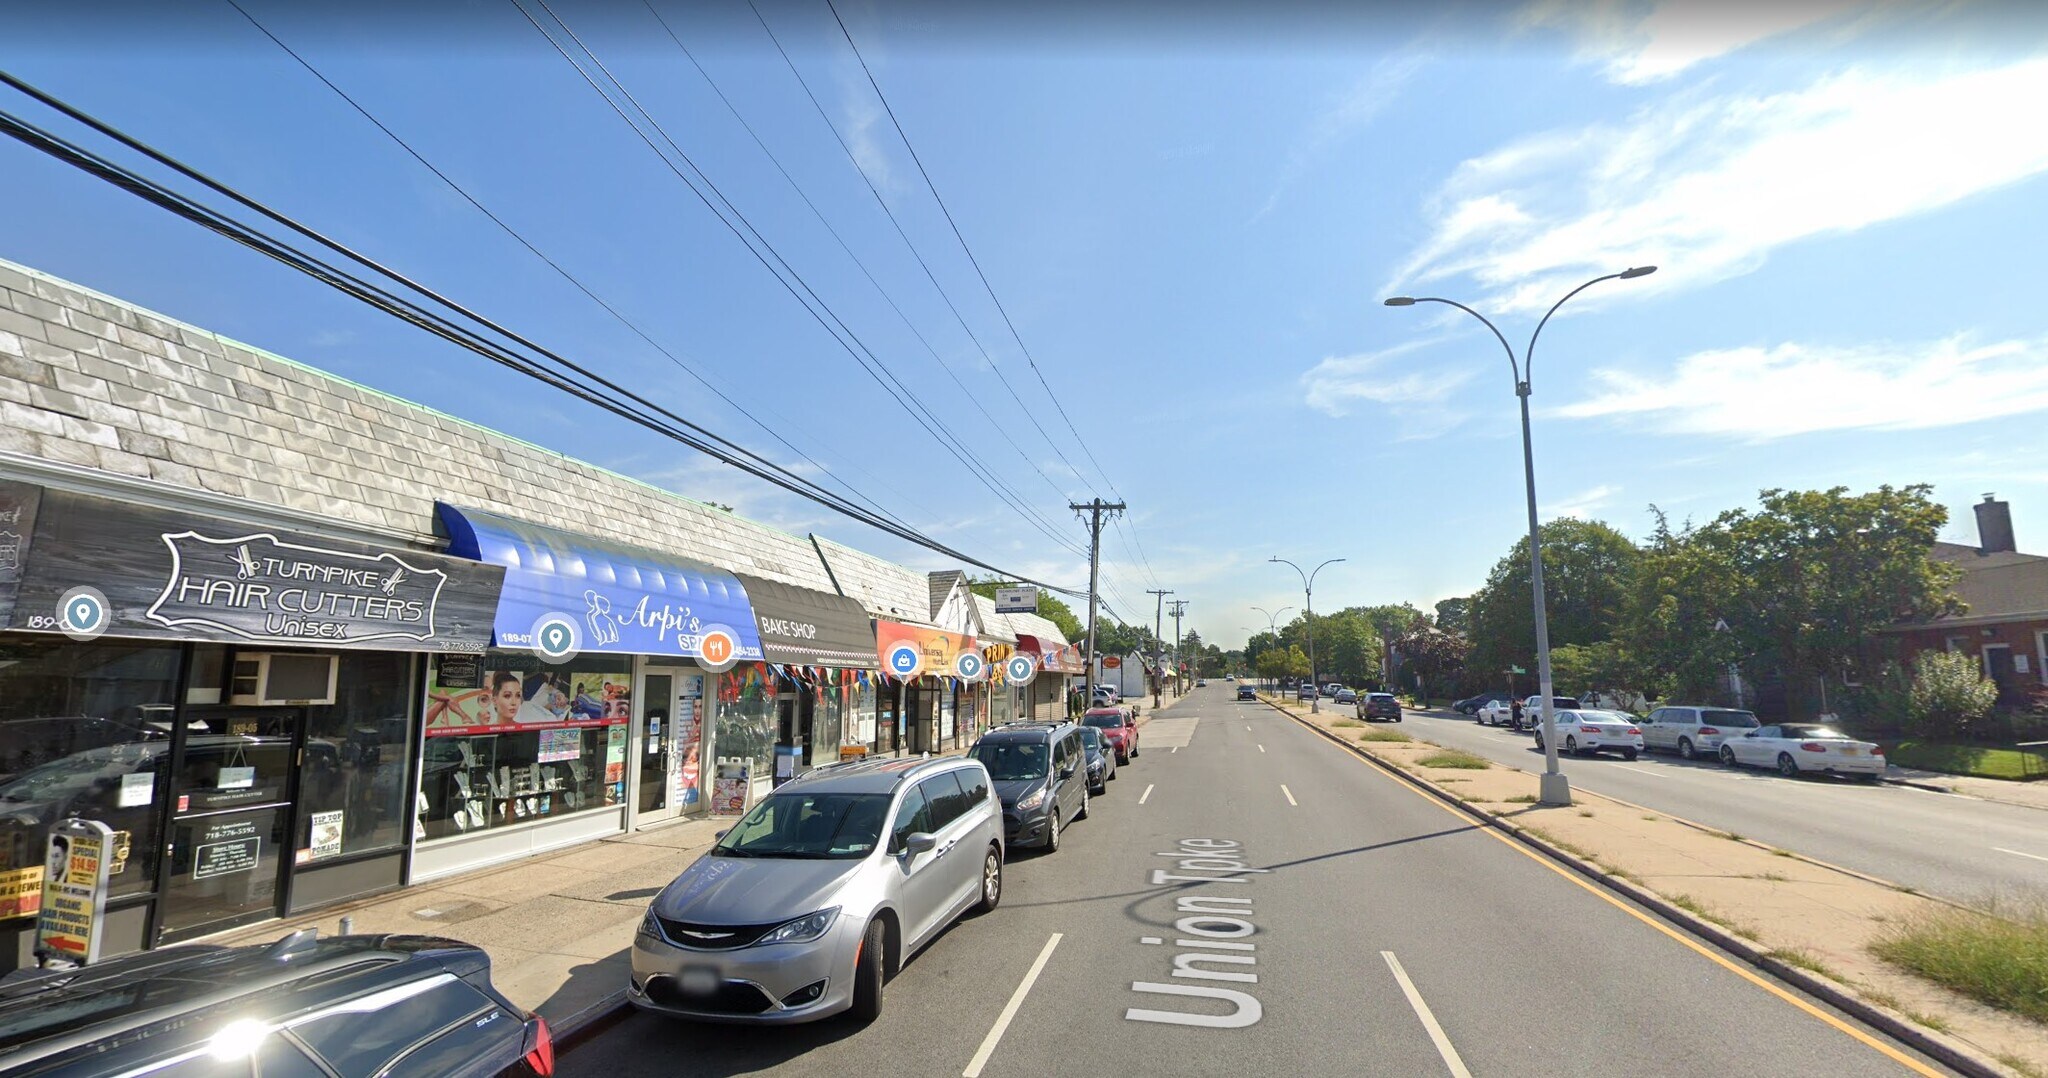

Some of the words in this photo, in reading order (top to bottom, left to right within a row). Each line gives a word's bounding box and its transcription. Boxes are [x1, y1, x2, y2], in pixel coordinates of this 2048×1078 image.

[263, 556, 379, 588] TURNPIKE
[179, 576, 270, 610] HAIR
[278, 588, 424, 622] CUTTERS
[26, 615, 71, 631] 189-0
[265, 612, 347, 639] Unisex
[617, 594, 703, 641] Arpi's
[761, 616, 786, 637] BAKE
[790, 621, 816, 640] SHOP
[327, 812, 343, 821] TOP
[16, 881, 42, 894] JEWE
[476, 1011, 499, 1028] SLE
